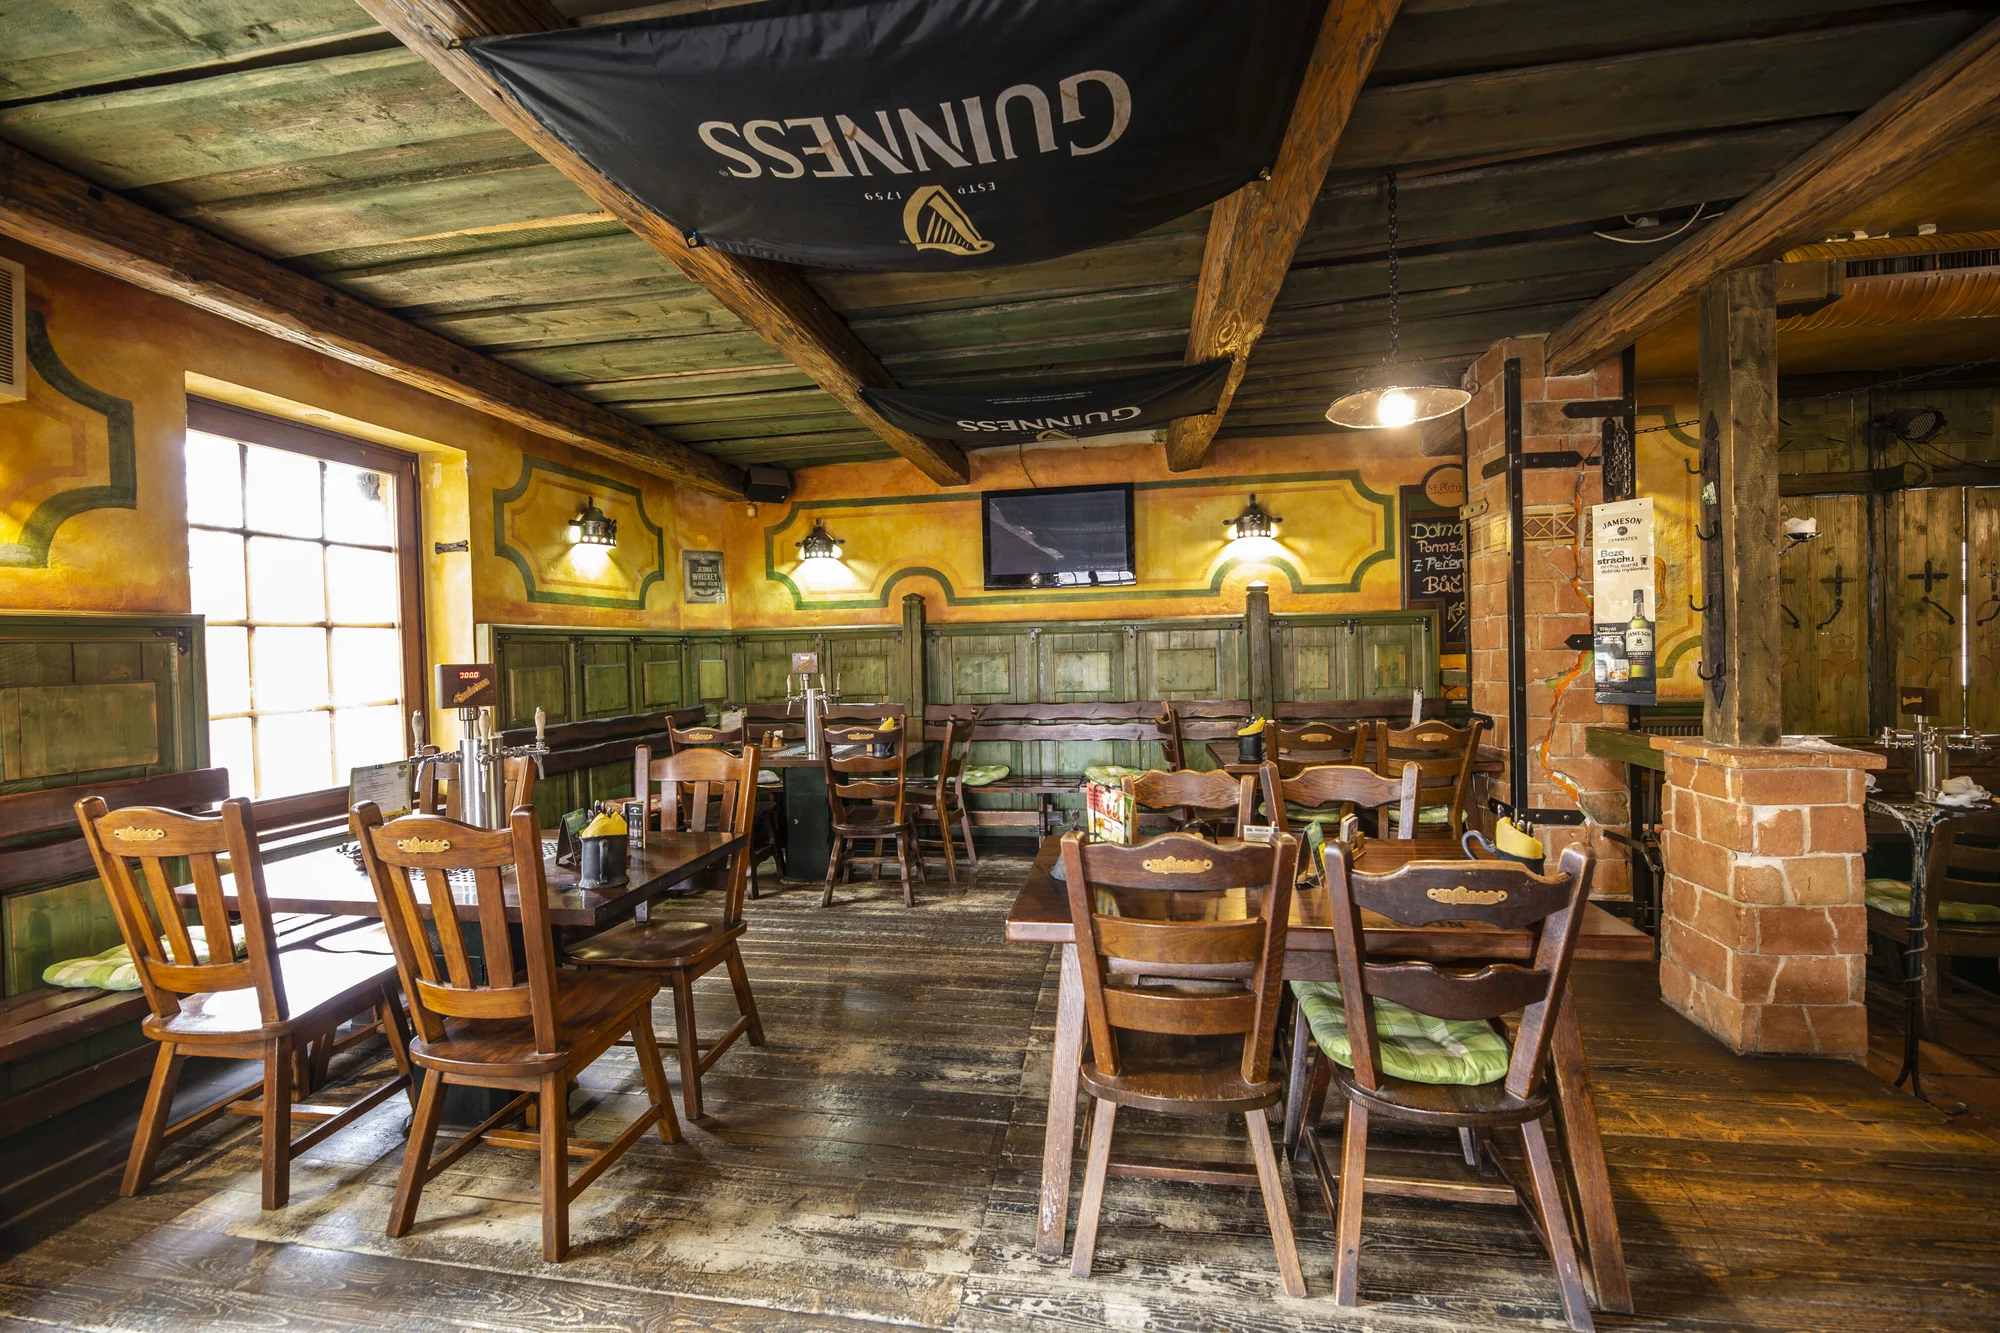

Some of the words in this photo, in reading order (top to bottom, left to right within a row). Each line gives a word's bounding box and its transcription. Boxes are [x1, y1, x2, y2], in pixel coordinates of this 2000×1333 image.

[698, 69, 1132, 179] GUINNESS
[864, 191, 902, 201] 1759
[956, 406, 1142, 432] GUINNESS
[1603, 517, 1642, 529] JAMESON
[1600, 550, 1625, 558] Beze
[1597, 556, 1634, 565] strachu
[1627, 630, 1651, 638] JAMESON
